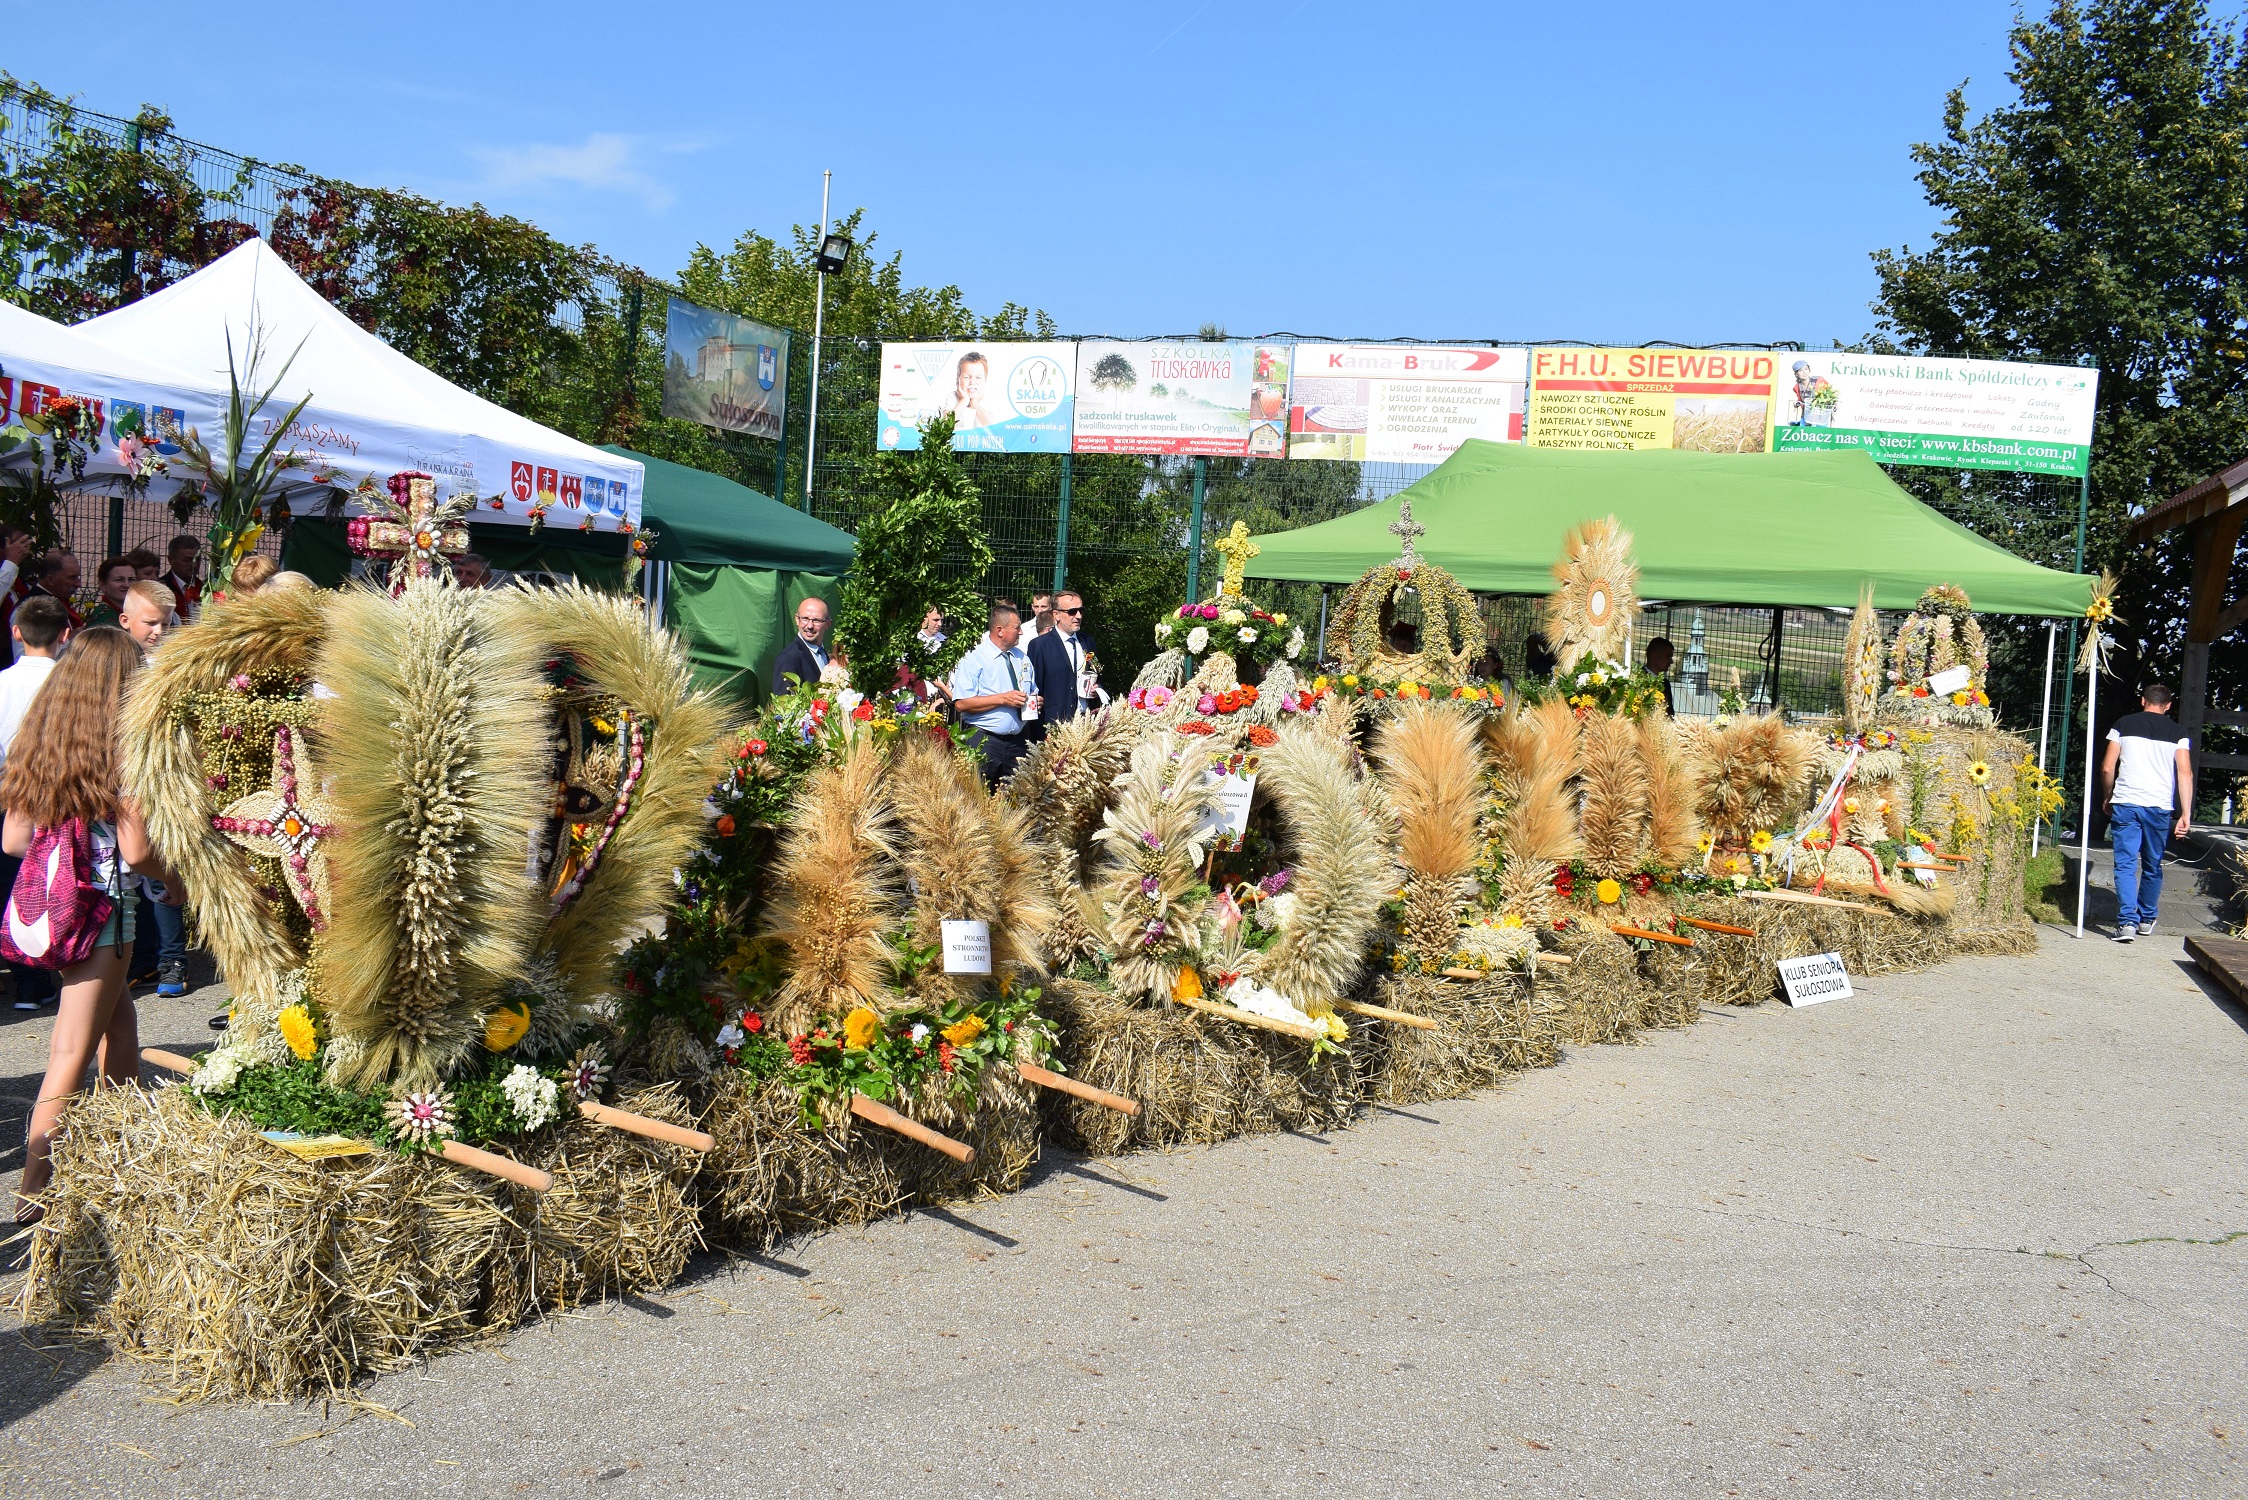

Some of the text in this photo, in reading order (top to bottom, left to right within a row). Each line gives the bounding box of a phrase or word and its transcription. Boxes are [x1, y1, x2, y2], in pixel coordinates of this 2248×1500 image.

[1151, 345, 1232, 359] SZKÓŁKA
[1328, 353, 1459, 371] Kama-Bruk
[1536, 353, 1773, 380] F.H.U. SIEWBUD
[1830, 361, 2050, 390] Krakowski Bank Spółdzielczy
[1389, 385, 1483, 395] USŁUGI BRUKARSKIE
[1626, 383, 1675, 392] SPRZEDAŻ
[1016, 388, 1056, 400] SKAŁA
[1540, 395, 1635, 405] NAWOZY SZTUCZNE
[1859, 387, 1883, 396] Karty
[1885, 388, 1922, 398] płatnicze
[1930, 390, 1973, 400] kredytowe
[1987, 394, 2016, 404] Lokaty
[1388, 395, 1501, 406] USŁUGI KANALIZACYJNE
[2027, 398, 2061, 410] Godny
[709, 393, 780, 430] Sułoszowa
[1025, 405, 1047, 414] OSM
[1388, 404, 1458, 414] WYKOPY ORAZ
[1540, 405, 1666, 417] ŚRODKI OCHRONY ROŚLIN
[1869, 401, 1914, 411] Bankowość
[1915, 404, 1965, 414] internetowa
[1973, 407, 2006, 416] mobilna
[1078, 411, 1177, 422] sadzonki truskawek
[1387, 414, 1477, 425] NIWELACJA TERENU
[1539, 417, 1633, 428] MATERIAŁY SIEWNE
[2019, 411, 2065, 422] Zaufania
[1004, 422, 1067, 432] www.osmskala.pl
[1078, 421, 1139, 432] kwalifikowanych
[1150, 423, 1178, 432] stopniu
[1180, 423, 1196, 433] Elity
[1201, 424, 1240, 434] Oryginału
[1386, 424, 1449, 434] OGRODZENIA
[1854, 415, 1995, 431] Ubezpieczenia Rachunki Kredyty
[1538, 428, 1656, 440] ARTYKUŁY OGRODNICZE
[2010, 424, 2071, 436] od 120 lat!
[263, 417, 360, 456] ZAPRASZAMY
[967, 435, 979, 448] POD
[1412, 443, 1433, 451] Piotr
[1538, 440, 1635, 450] MASZYNY ROLNICZE
[1780, 428, 2077, 463] Zobacz nas w sieci: www.kbsbank.com.pl
[463, 461, 474, 469] LGD
[1883, 452, 1909, 461] siedzibą
[1921, 454, 1954, 462] Krakowie,
[1957, 456, 1977, 465] Rynek
[1980, 457, 2011, 466] Kleparski
[2024, 460, 2048, 469] 31-150
[2050, 462, 2076, 471] Kraków
[416, 460, 474, 479] JURAJSKA KRAINA
[1784, 960, 1845, 981] KLUB SENIORA
[1794, 977, 1846, 998] SUŁOSZOWA
